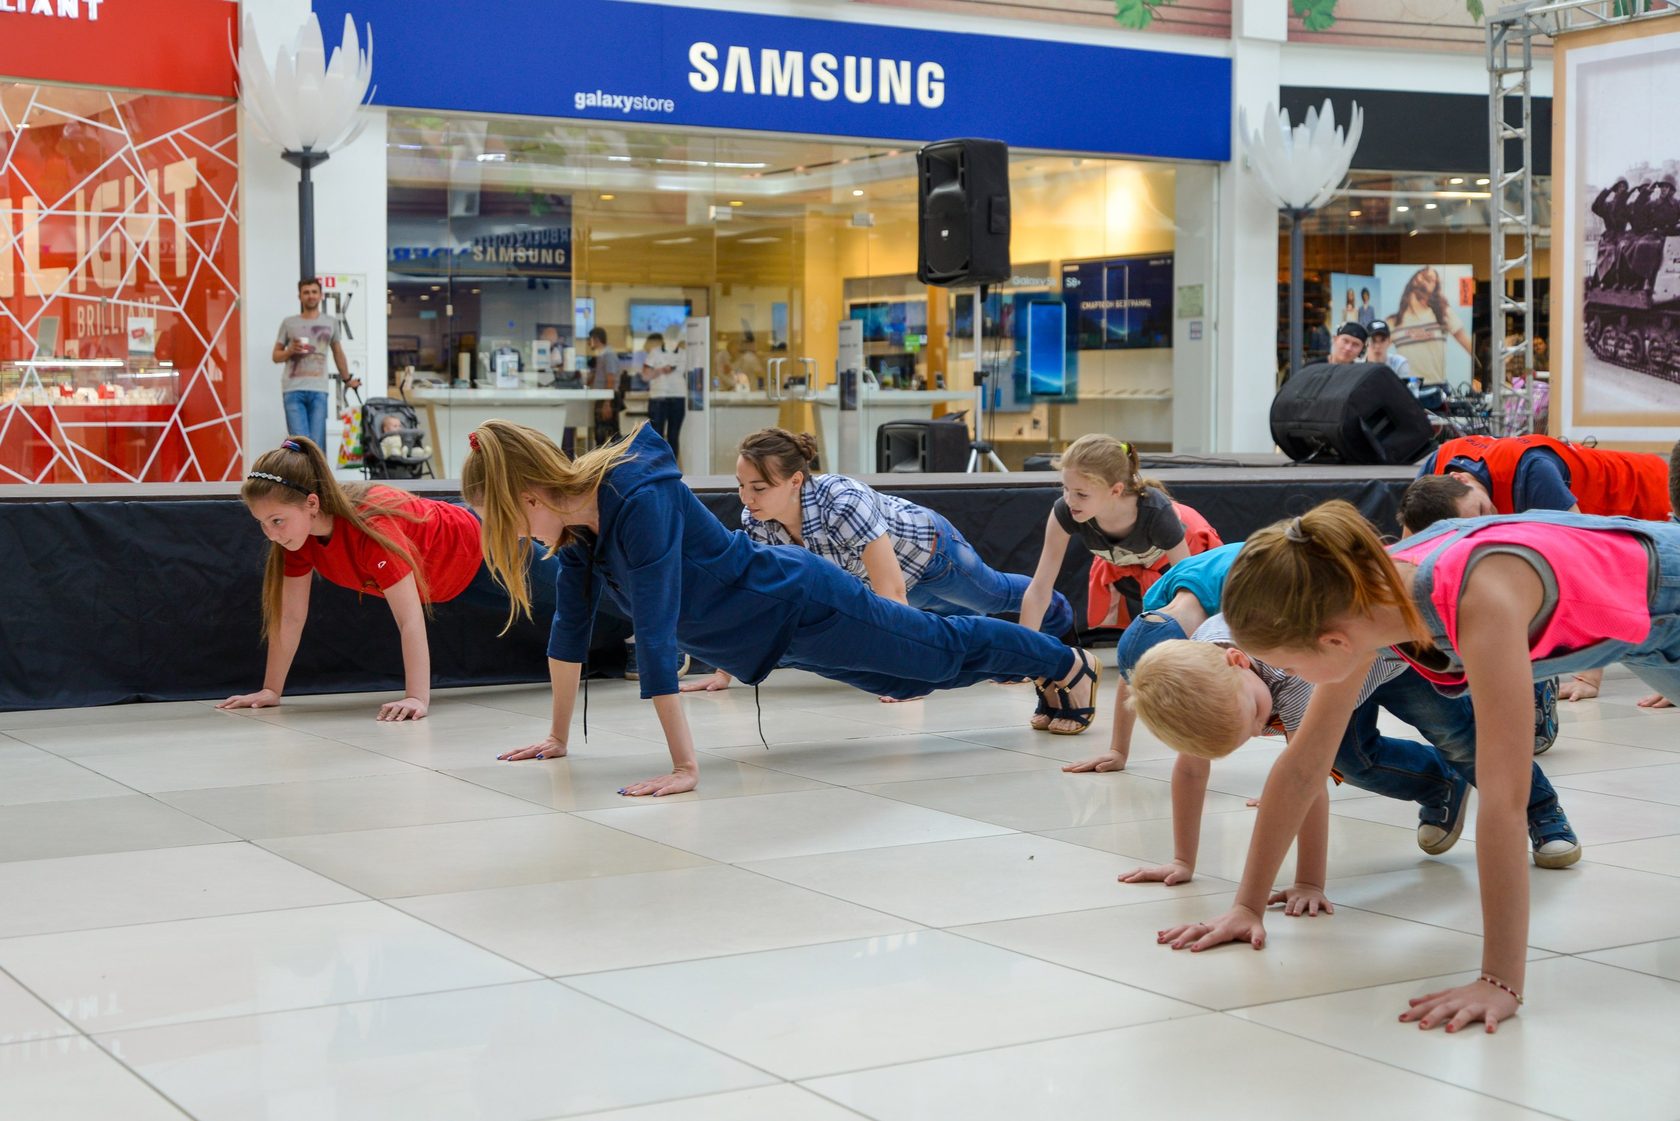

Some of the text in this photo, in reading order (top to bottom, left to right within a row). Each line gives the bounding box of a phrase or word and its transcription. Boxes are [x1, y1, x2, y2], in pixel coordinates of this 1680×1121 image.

[688, 41, 946, 109] SAMSUNG
[0, 157, 197, 299] LIGHT
[473, 246, 566, 264] SAMSUNG
